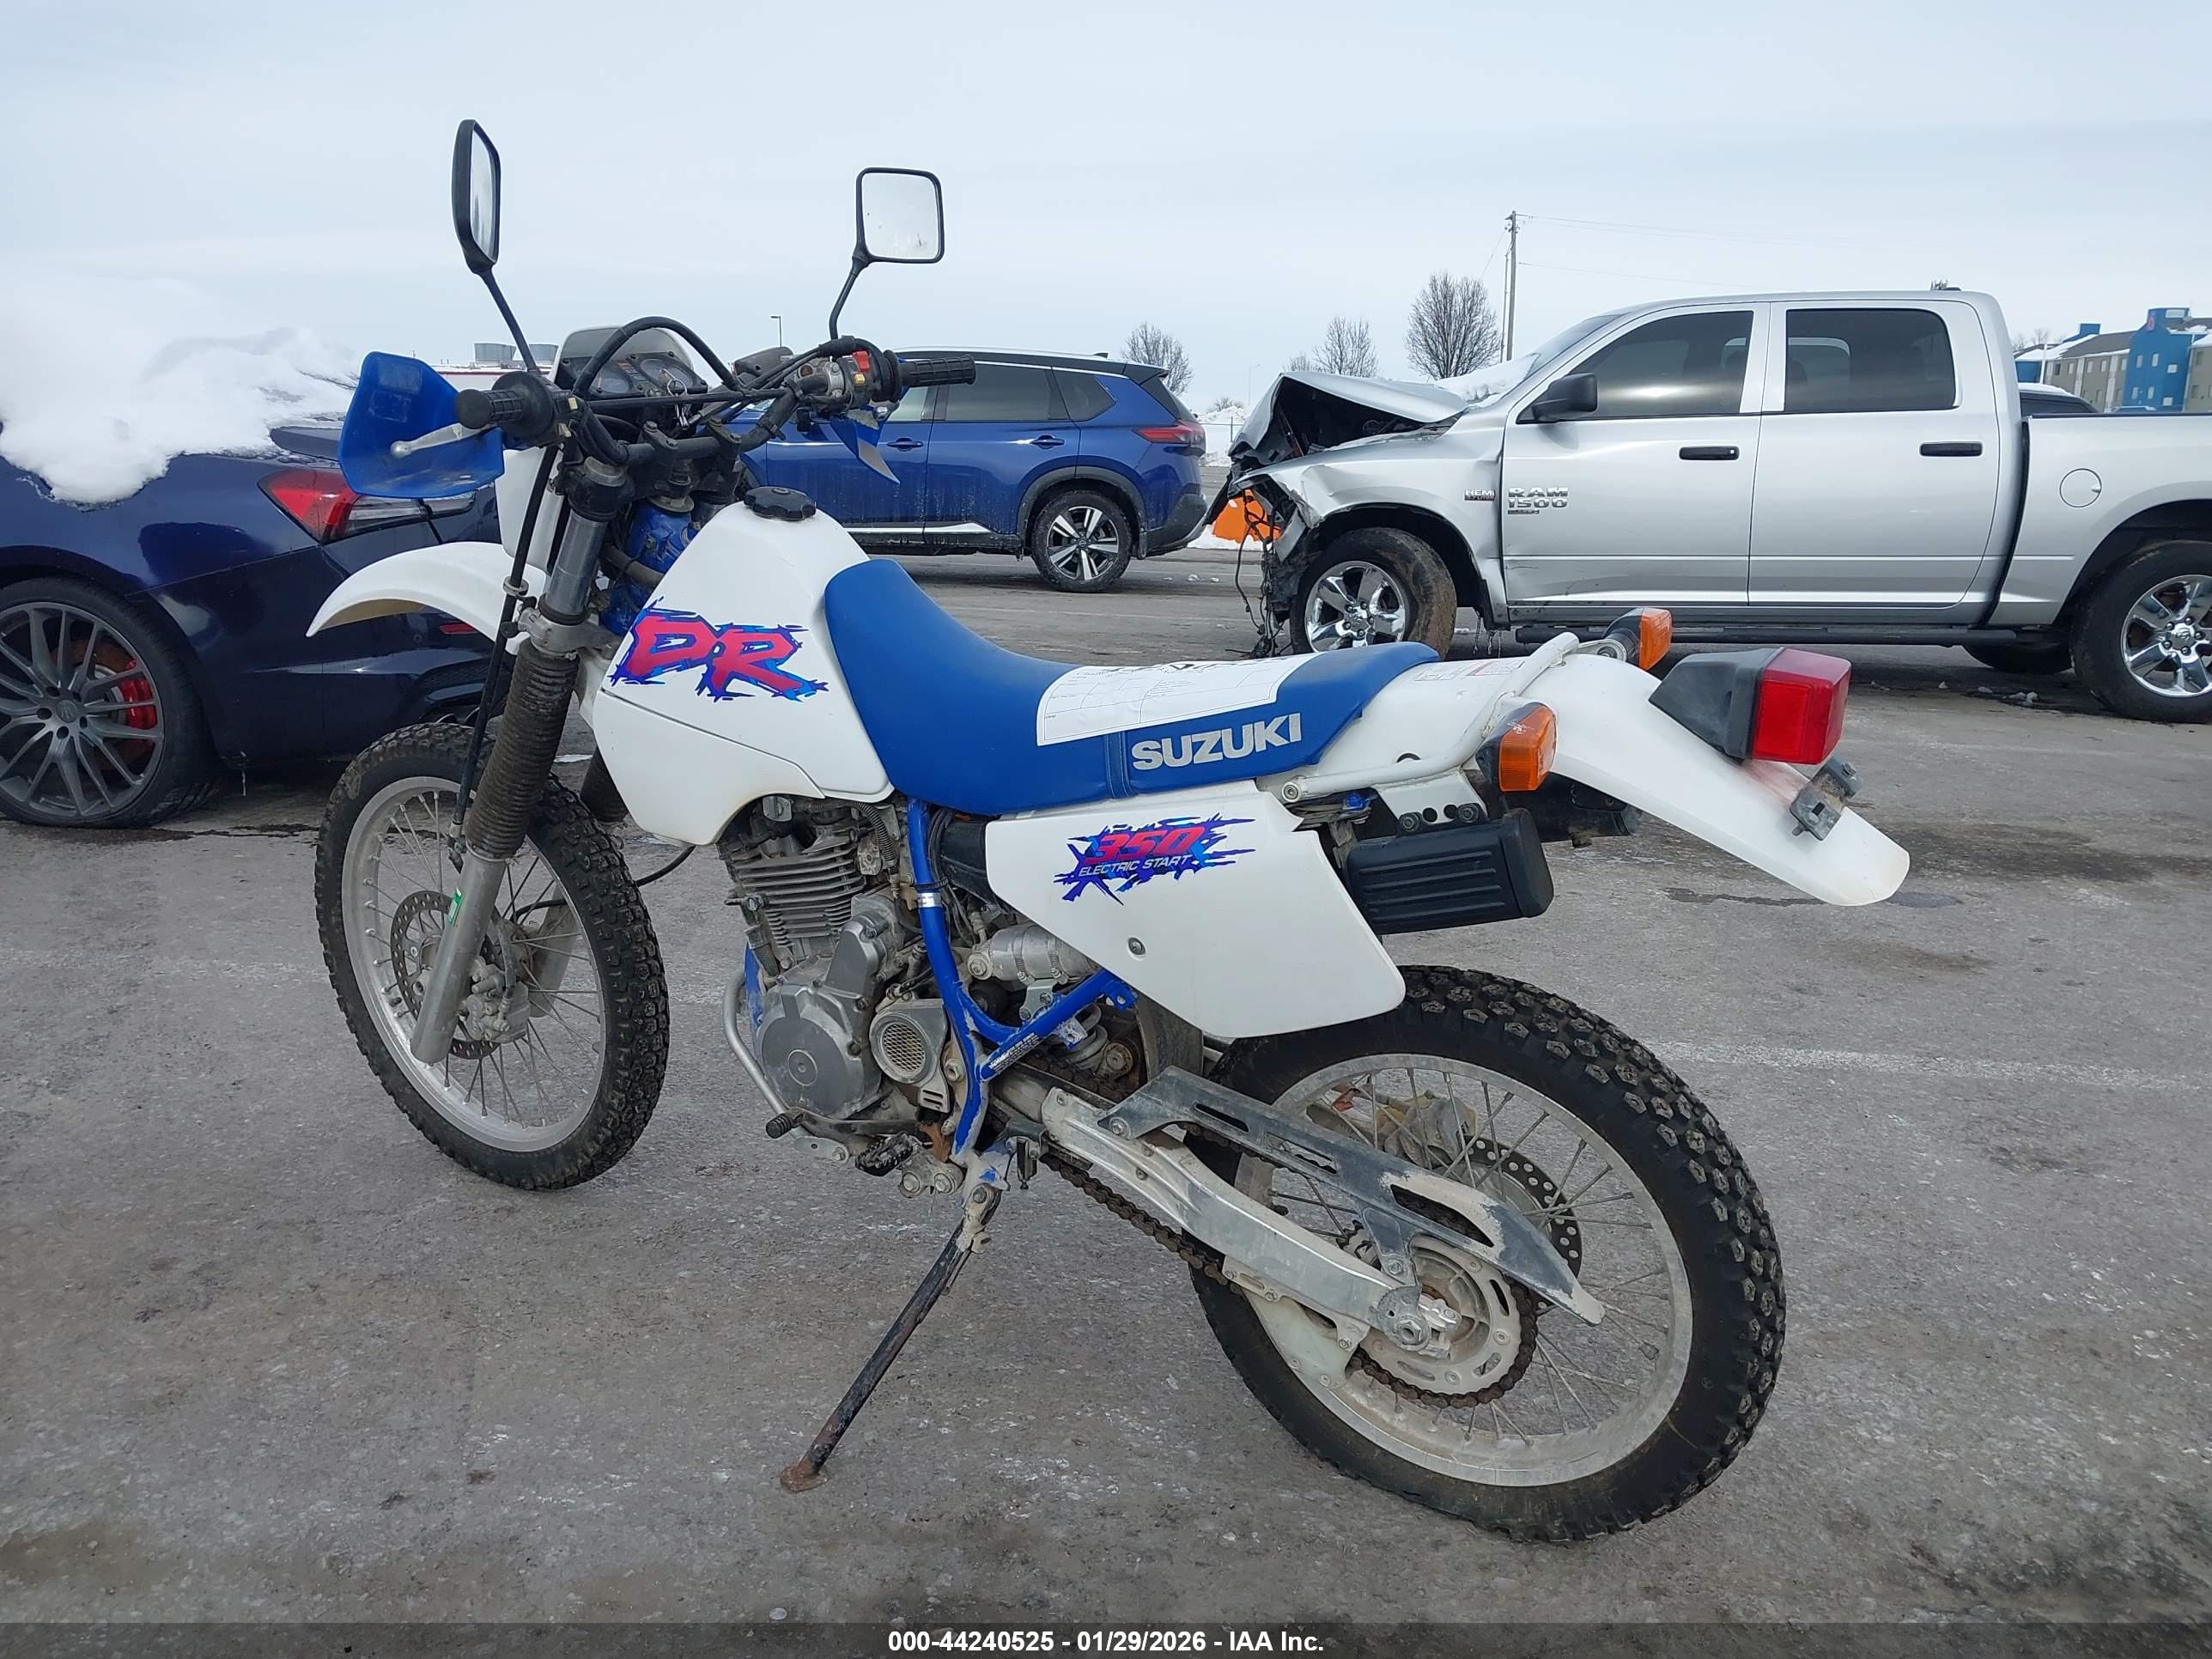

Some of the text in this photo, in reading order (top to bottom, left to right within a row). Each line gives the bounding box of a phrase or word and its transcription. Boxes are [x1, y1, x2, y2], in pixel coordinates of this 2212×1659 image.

[1508, 487, 1568, 497] RAM
[1508, 498, 1568, 508] 1500
[622, 610, 811, 697] DR
[1132, 713, 1302, 770] SUZUKI
[1085, 826, 1206, 865] 350
[1079, 854, 1193, 878] ELECTRIC START
